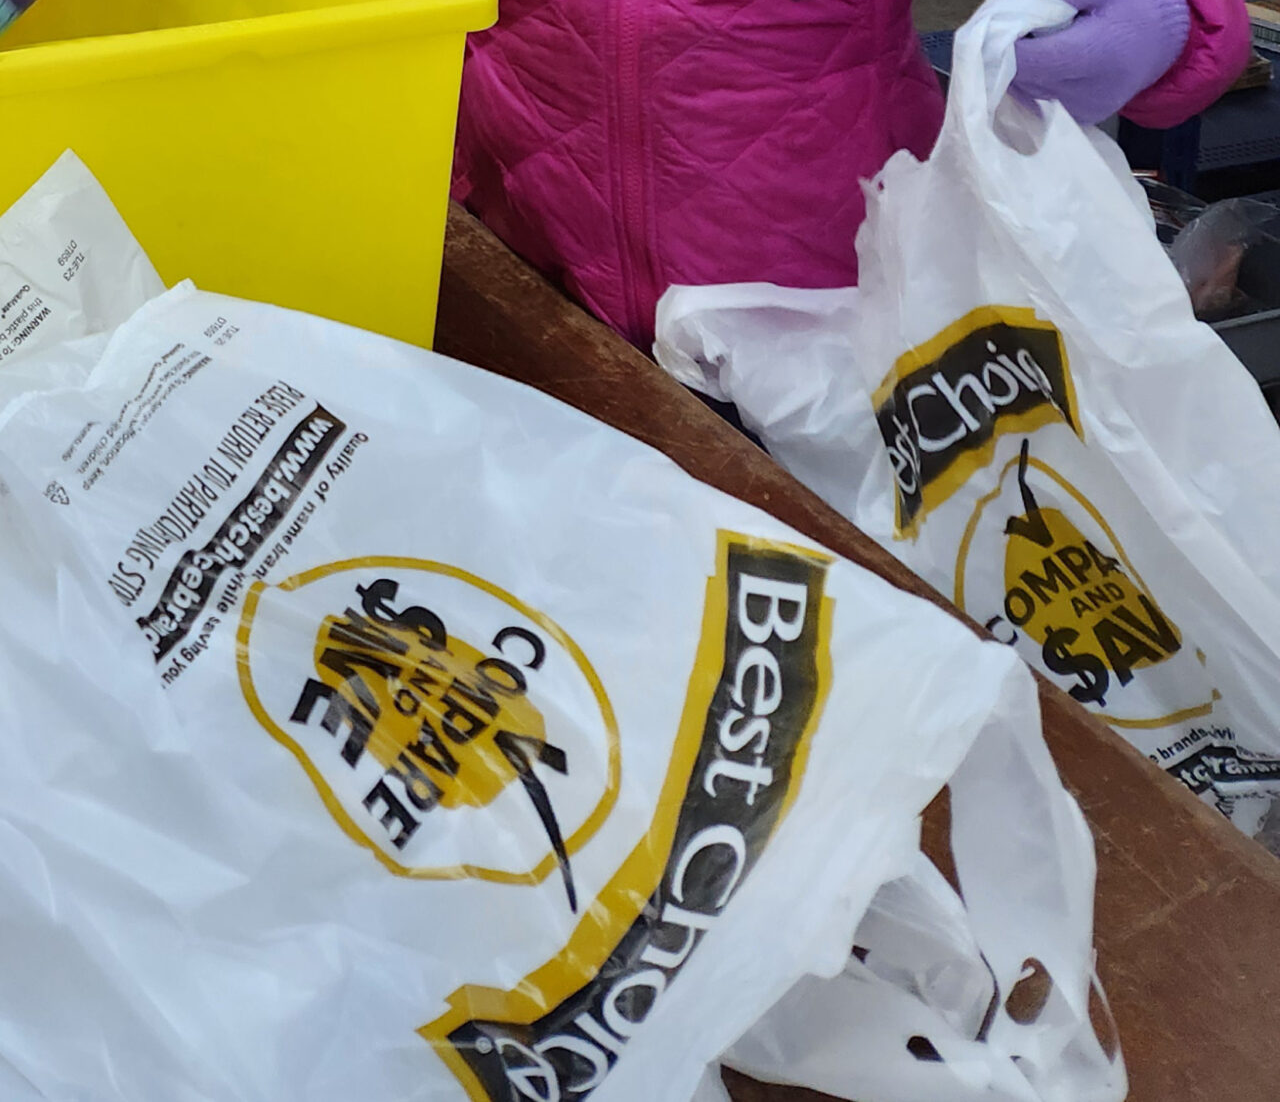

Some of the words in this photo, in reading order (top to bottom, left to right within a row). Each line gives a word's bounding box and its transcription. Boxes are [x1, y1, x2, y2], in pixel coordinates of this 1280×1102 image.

[6, 308, 29, 336] plastic
[31, 297, 44, 311] this
[13, 306, 51, 347] WARNING:
[216, 406, 277, 473] RETURN
[327, 431, 370, 481] Quality
[885, 414, 921, 496] est
[314, 481, 330, 504] of
[283, 505, 318, 546] name
[1070, 580, 1126, 619] AND
[702, 572, 809, 807] Best
